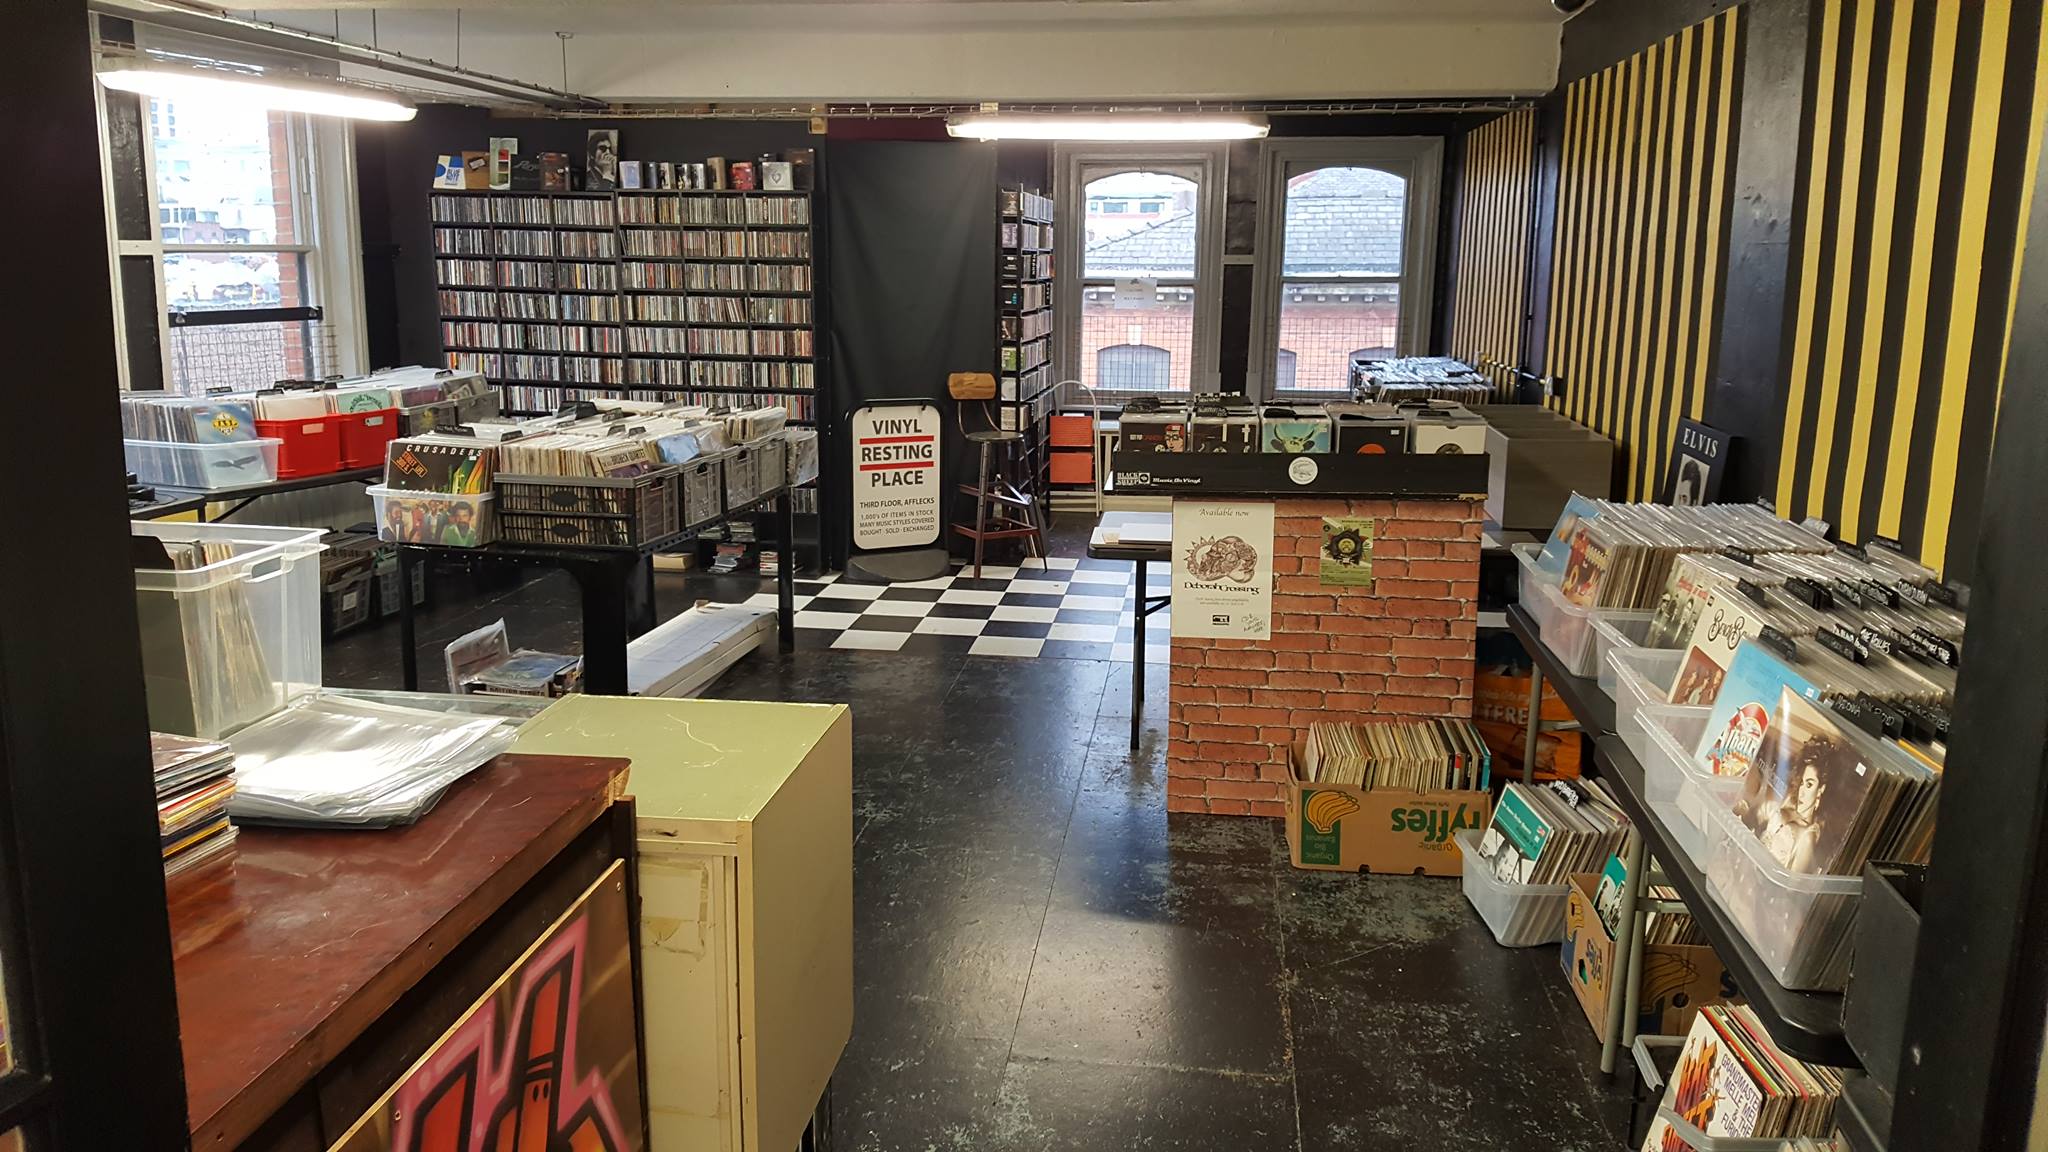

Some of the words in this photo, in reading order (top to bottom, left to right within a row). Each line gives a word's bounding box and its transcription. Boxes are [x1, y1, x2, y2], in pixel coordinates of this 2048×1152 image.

[872, 419, 922, 435] VINYL
[406, 444, 484, 457] CRUSADERS
[1682, 427, 1719, 458] ELVIS
[861, 444, 933, 462] RESTING
[871, 470, 924, 487] PLACE
[904, 497, 935, 506] AFFLECKS
[890, 511, 907, 519] ITEMS
[915, 509, 934, 517] STOCK
[1199, 507, 1233, 517] Available
[860, 520, 875, 528] MANY
[892, 518, 911, 526] STYLES
[911, 517, 935, 525] COVERED
[860, 528, 882, 536] BOUGHT
[885, 526, 900, 534] SOLD
[903, 524, 935, 533] EXCHANGED
[1724, 1076, 1744, 1109] MELLE
[1742, 1103, 1756, 1128] MEL
[1721, 1112, 1741, 1137] FURIO
[1738, 1115, 1753, 1137] THE
